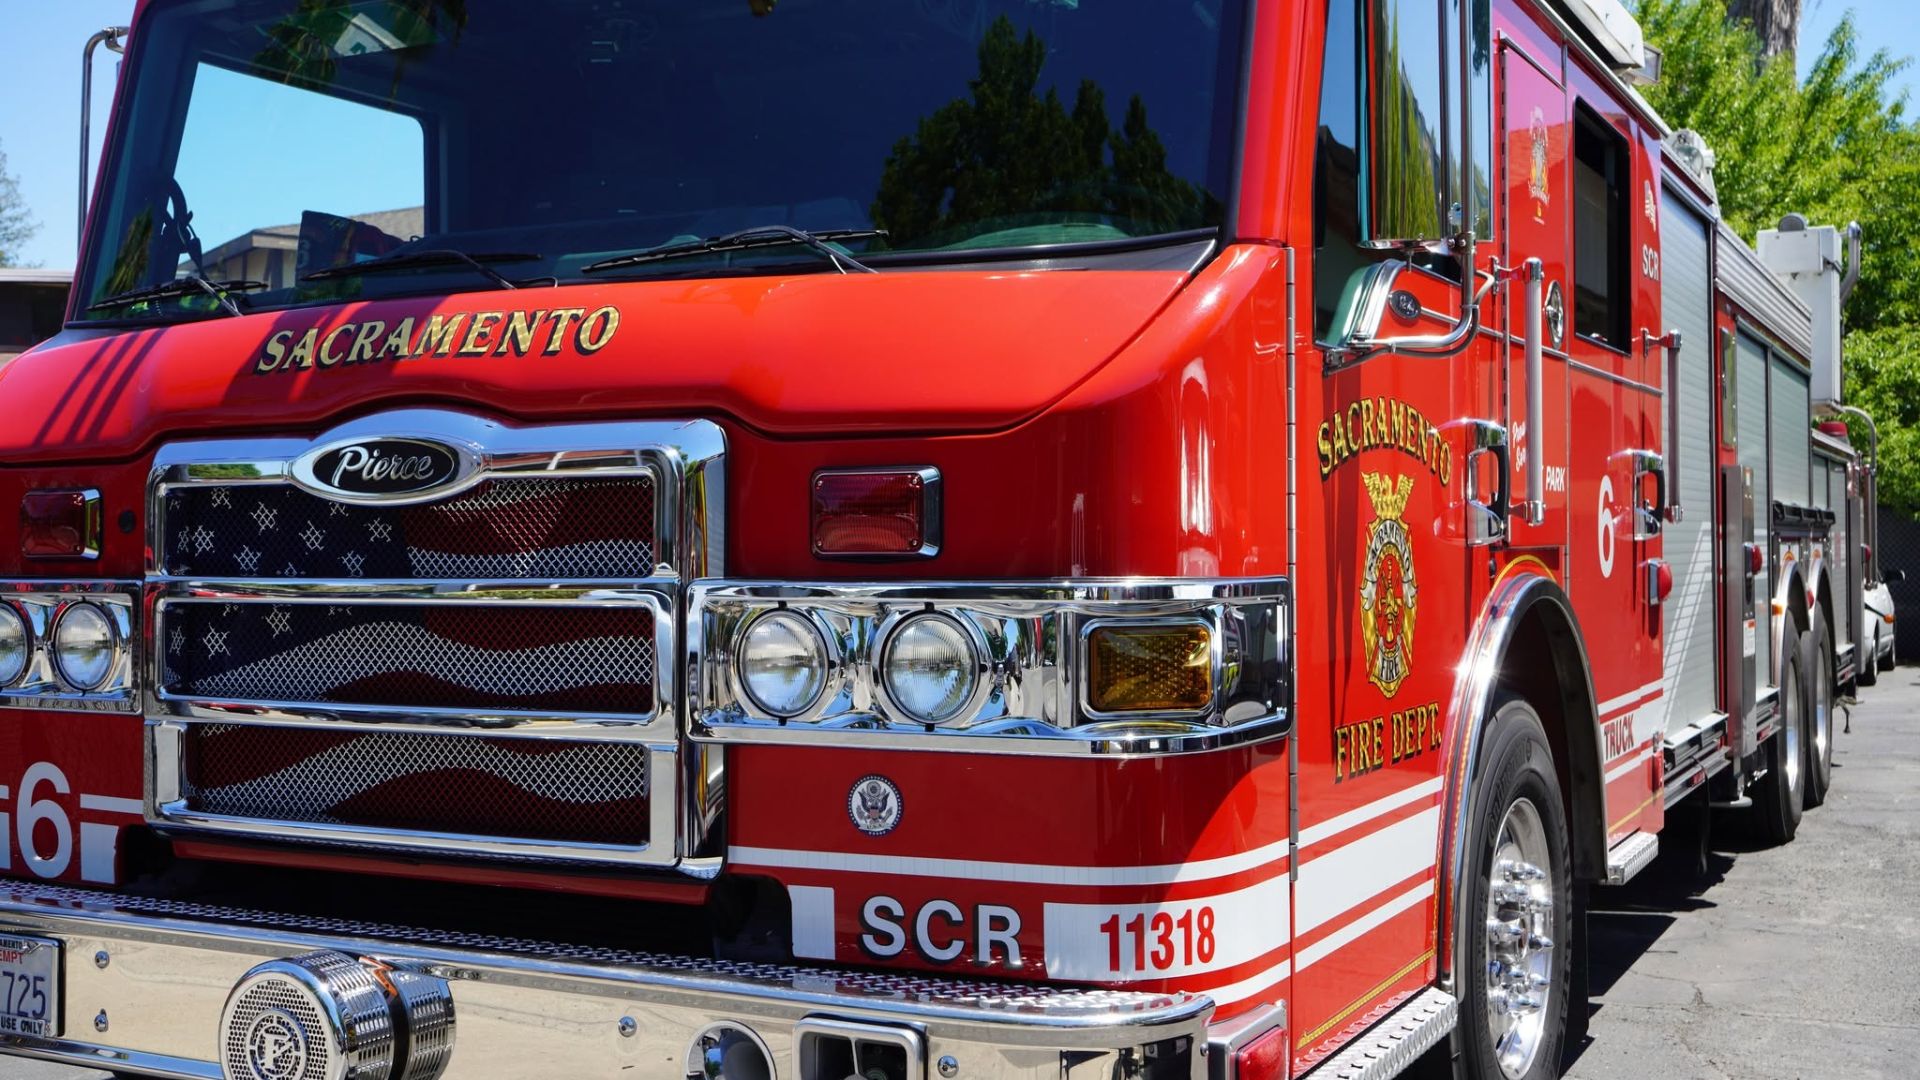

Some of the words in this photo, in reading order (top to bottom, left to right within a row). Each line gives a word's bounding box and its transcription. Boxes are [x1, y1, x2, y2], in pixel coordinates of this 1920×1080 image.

[1642, 244, 1660, 281] SCR
[253, 305, 622, 375] SACRAMENTO
[331, 446, 434, 488] Pierce
[1317, 396, 1452, 487] SACRAMENTO
[1545, 465, 1566, 492] PARK
[1598, 474, 1615, 579] 6
[1380, 656, 1400, 681] FIRE
[1335, 716, 1384, 784] FIRE
[1604, 713, 1634, 761] TRUCK
[16, 761, 73, 879] 6
[861, 895, 1022, 970] SCR
[1100, 905, 1216, 972] 11318
[2, 970, 46, 1020] 725
[1, 1015, 17, 1031] USE
[20, 1019, 44, 1035] ONLY
